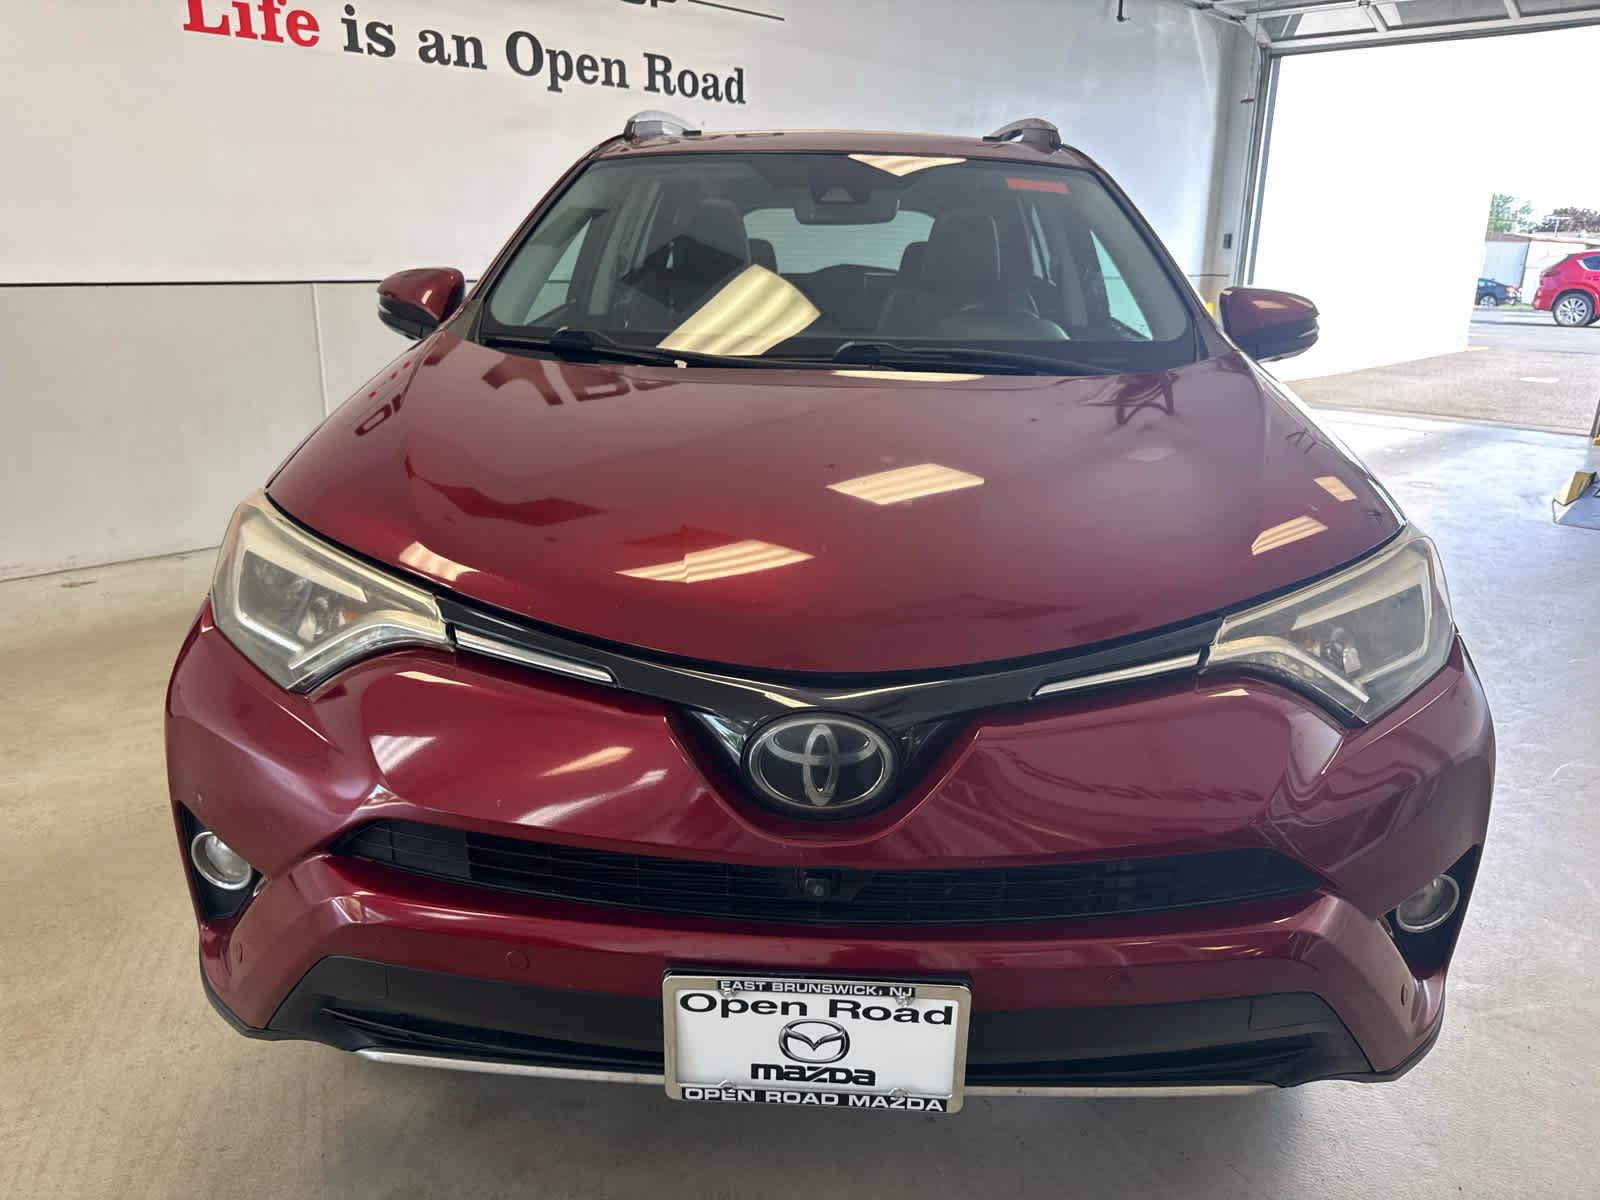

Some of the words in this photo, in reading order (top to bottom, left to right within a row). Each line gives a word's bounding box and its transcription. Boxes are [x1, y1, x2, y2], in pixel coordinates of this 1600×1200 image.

[183, 0, 320, 48] Life
[341, 4, 396, 58] is
[418, 26, 488, 70] an
[505, 30, 630, 93] Open
[643, 52, 746, 104] Road
[718, 980, 768, 992] EAST
[889, 986, 914, 997] NJ
[680, 992, 808, 1018] Open
[829, 999, 953, 1025] Road
[751, 1063, 876, 1086] mazda
[685, 1087, 755, 1102] OPEN
[765, 1091, 839, 1106] ROAD
[849, 1094, 944, 1112] MAZDA
